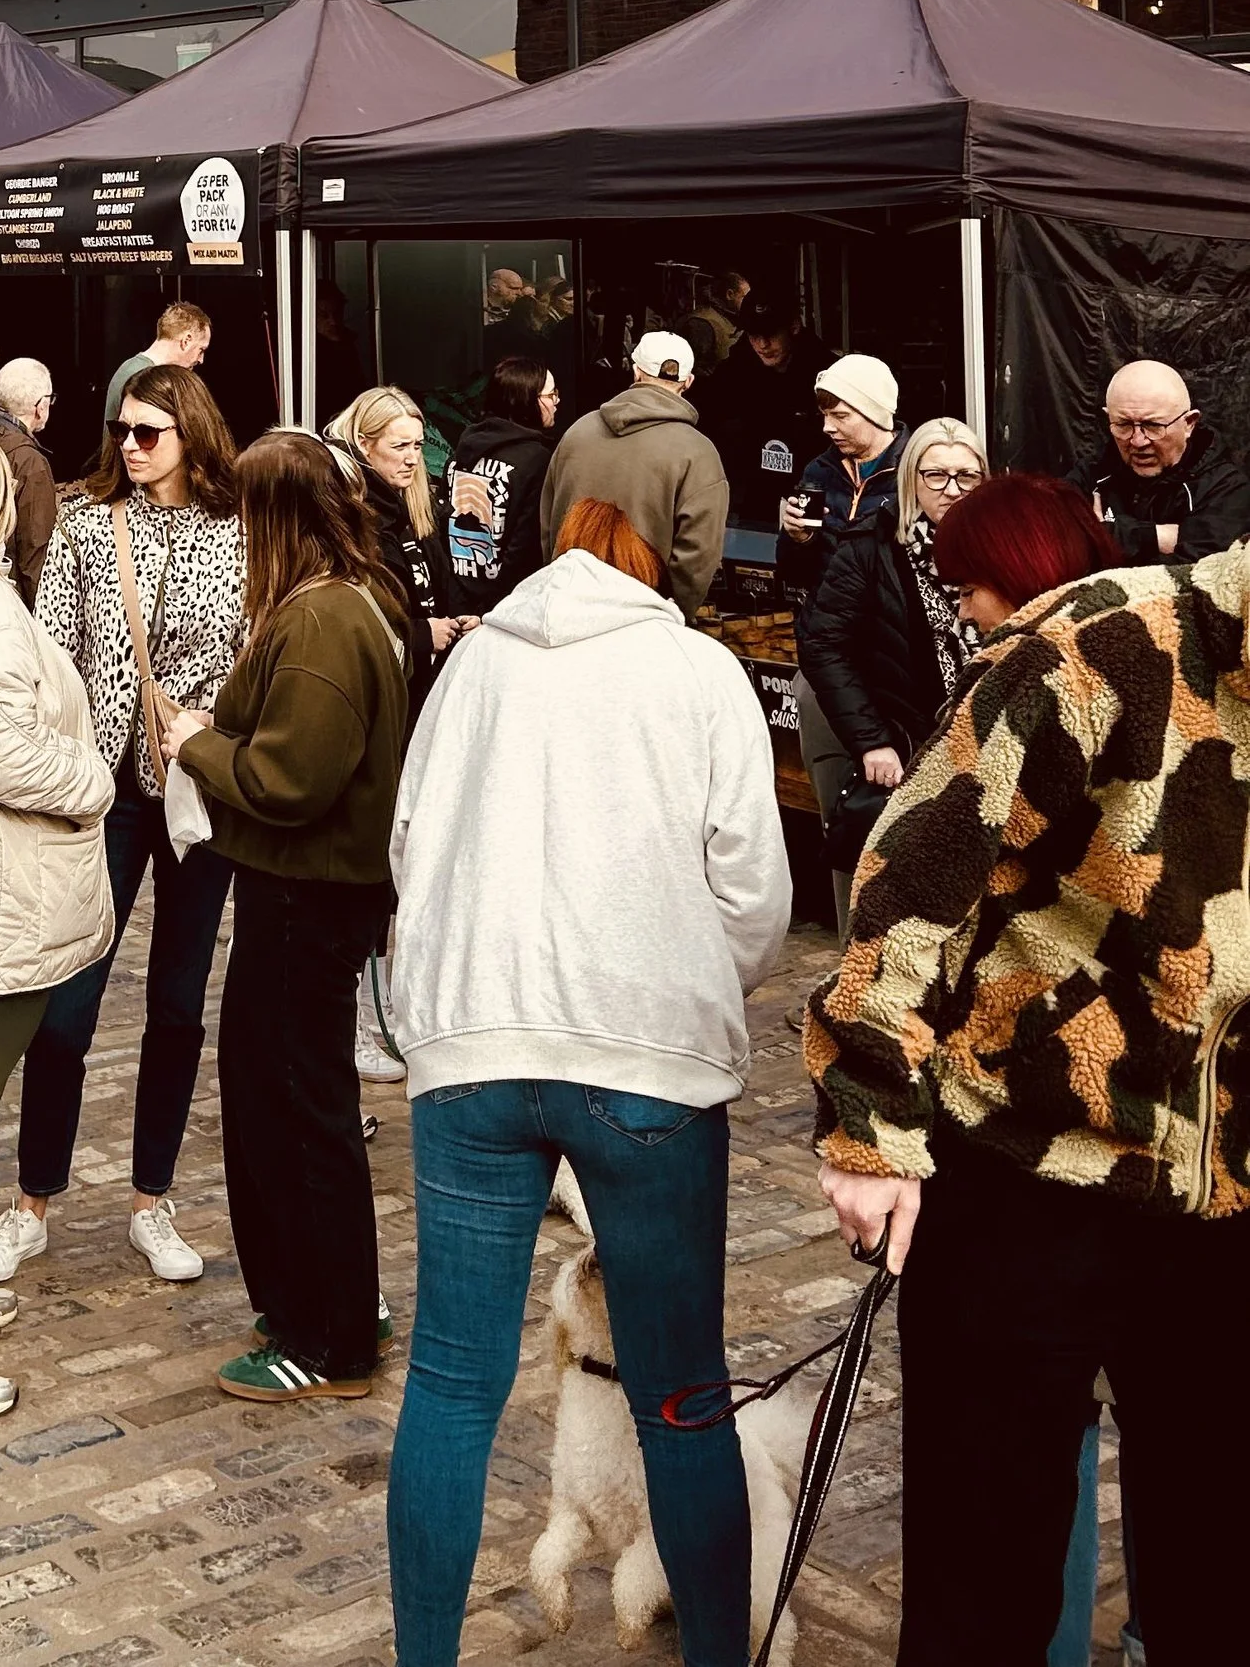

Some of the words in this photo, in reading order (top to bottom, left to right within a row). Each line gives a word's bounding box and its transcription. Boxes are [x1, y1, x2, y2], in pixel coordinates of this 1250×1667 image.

[102, 172, 126, 184] BROON
[126, 170, 140, 182] ALE
[197, 175, 208, 188] £5
[210, 174, 229, 187] PER
[8, 192, 52, 204] CUMBERLAND
[93, 188, 116, 200] BLACK
[122, 186, 146, 198] WHITE
[199, 189, 225, 203] PACK
[96, 203, 111, 215] HOG
[111, 202, 135, 214] ROAST
[196, 204, 209, 218] OR
[210, 204, 229, 217] ANY
[29, 222, 55, 233] SIZZLER
[96, 219, 132, 231] JALAPENO
[191, 219, 197, 232] 3
[198, 219, 218, 232] FOR
[219, 218, 236, 231] £14
[81, 236, 123, 248] BREAKFAST
[123, 234, 154, 246] PATTIES
[70, 252, 86, 263] SALT
[92, 252, 121, 263] PEPPER
[121, 251, 139, 262] BEEF
[140, 250, 173, 262] BURGERS
[193, 250, 206, 259] MIX
[206, 250, 217, 258] AND
[217, 250, 238, 259] MATCH
[463, 457, 515, 484] AUX
